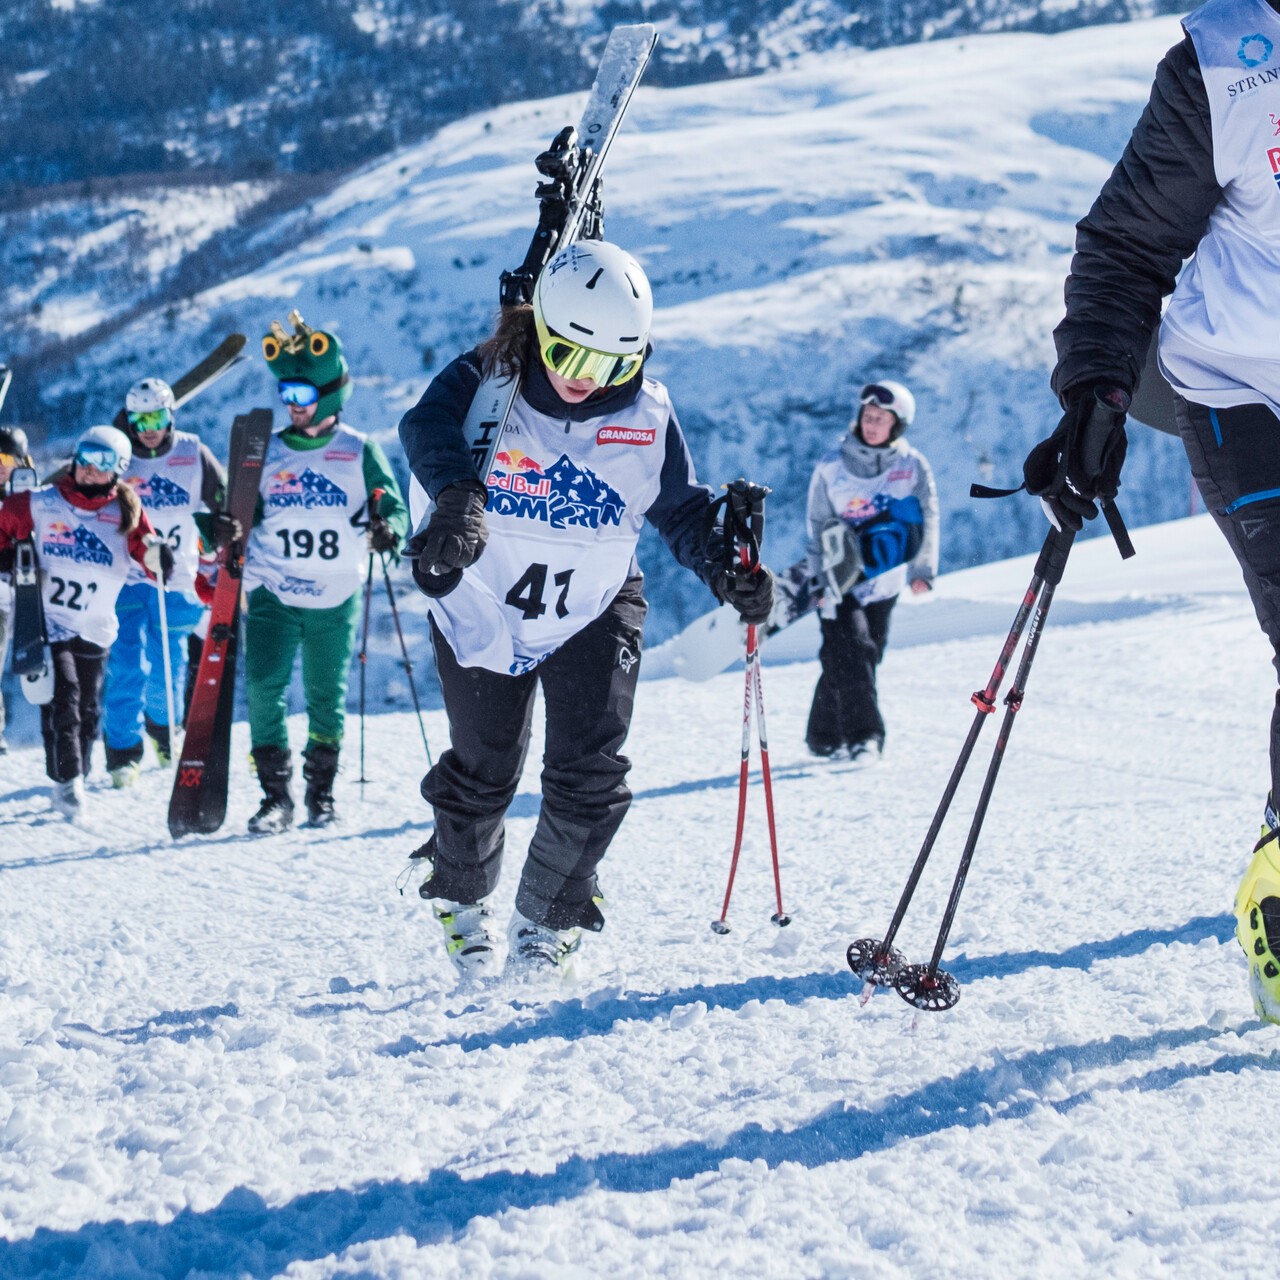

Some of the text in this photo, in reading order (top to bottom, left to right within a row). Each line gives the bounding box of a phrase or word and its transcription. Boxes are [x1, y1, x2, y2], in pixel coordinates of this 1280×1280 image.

[599, 429, 653, 443] GRANDIOSA
[487, 474, 552, 496] ed Bull
[276, 529, 340, 560] 198
[278, 575, 326, 597] Ford
[504, 562, 576, 620] 41
[1027, 608, 1042, 647] CARBON
